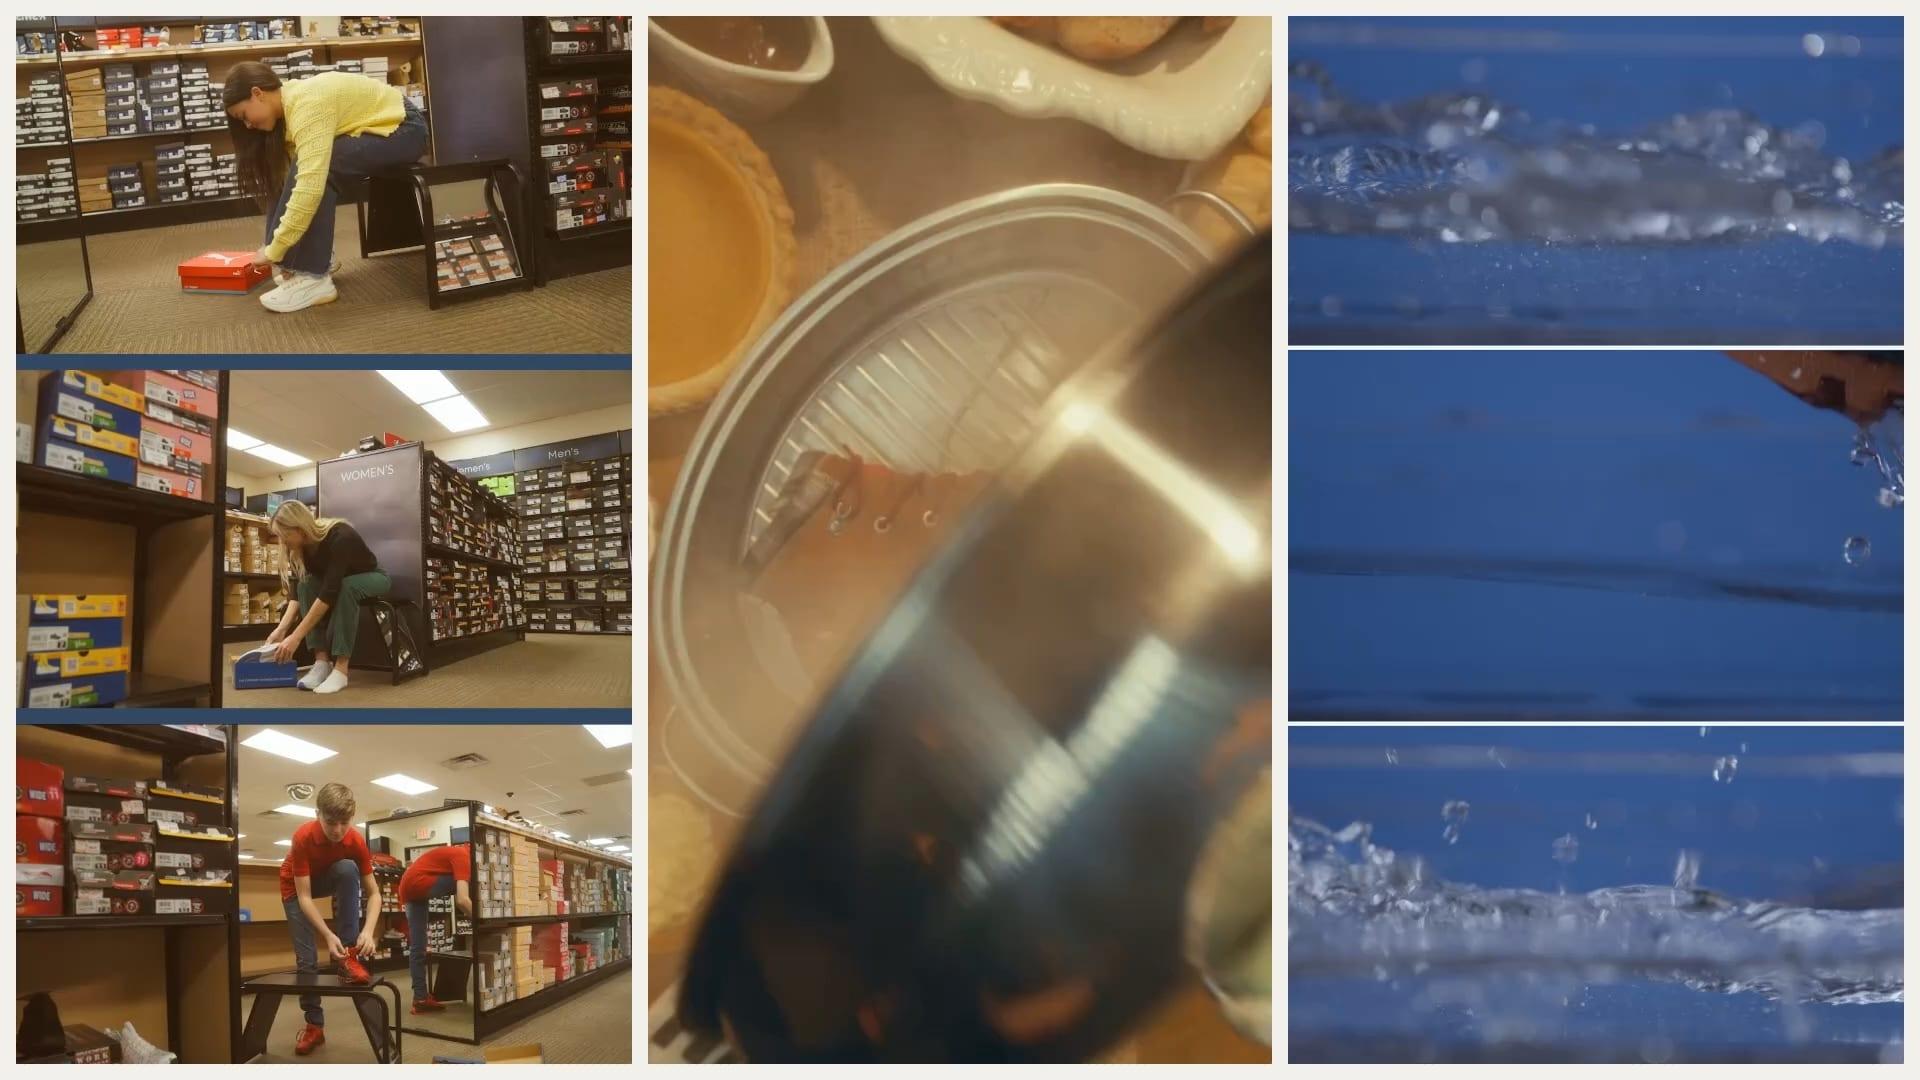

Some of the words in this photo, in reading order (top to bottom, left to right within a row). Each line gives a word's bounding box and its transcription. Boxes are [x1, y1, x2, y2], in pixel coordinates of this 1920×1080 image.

[548, 447, 579, 460] Men's
[341, 464, 394, 481] WOMEN'S
[456, 463, 490, 474] omen's
